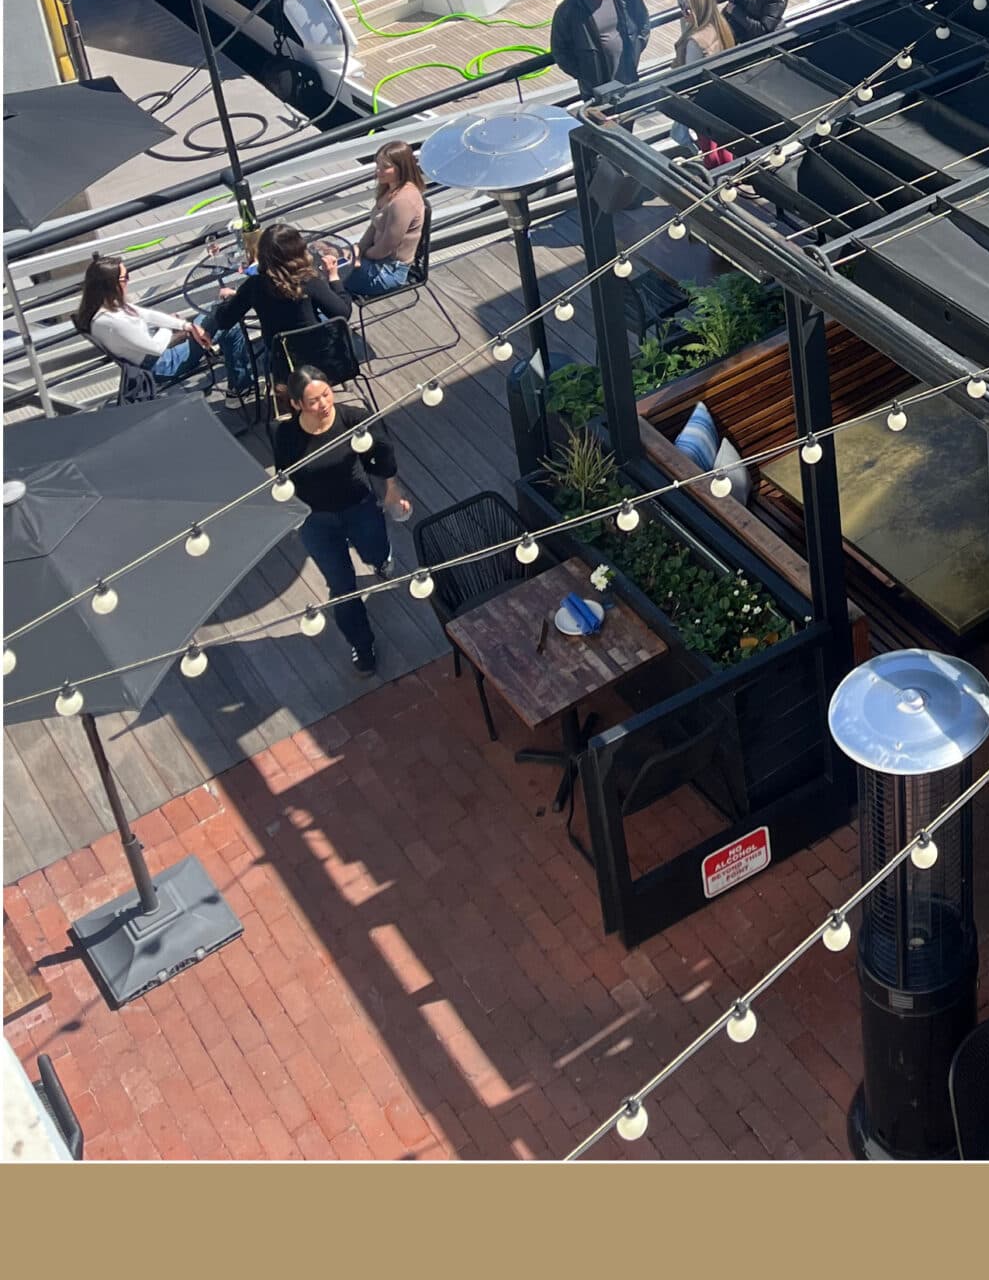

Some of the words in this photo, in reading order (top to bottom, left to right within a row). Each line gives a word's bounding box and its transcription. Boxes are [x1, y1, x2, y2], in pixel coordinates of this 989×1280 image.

[714, 844, 758, 872] ALCOHOL
[728, 844, 743, 858] NO
[711, 862, 743, 882] BEYOND
